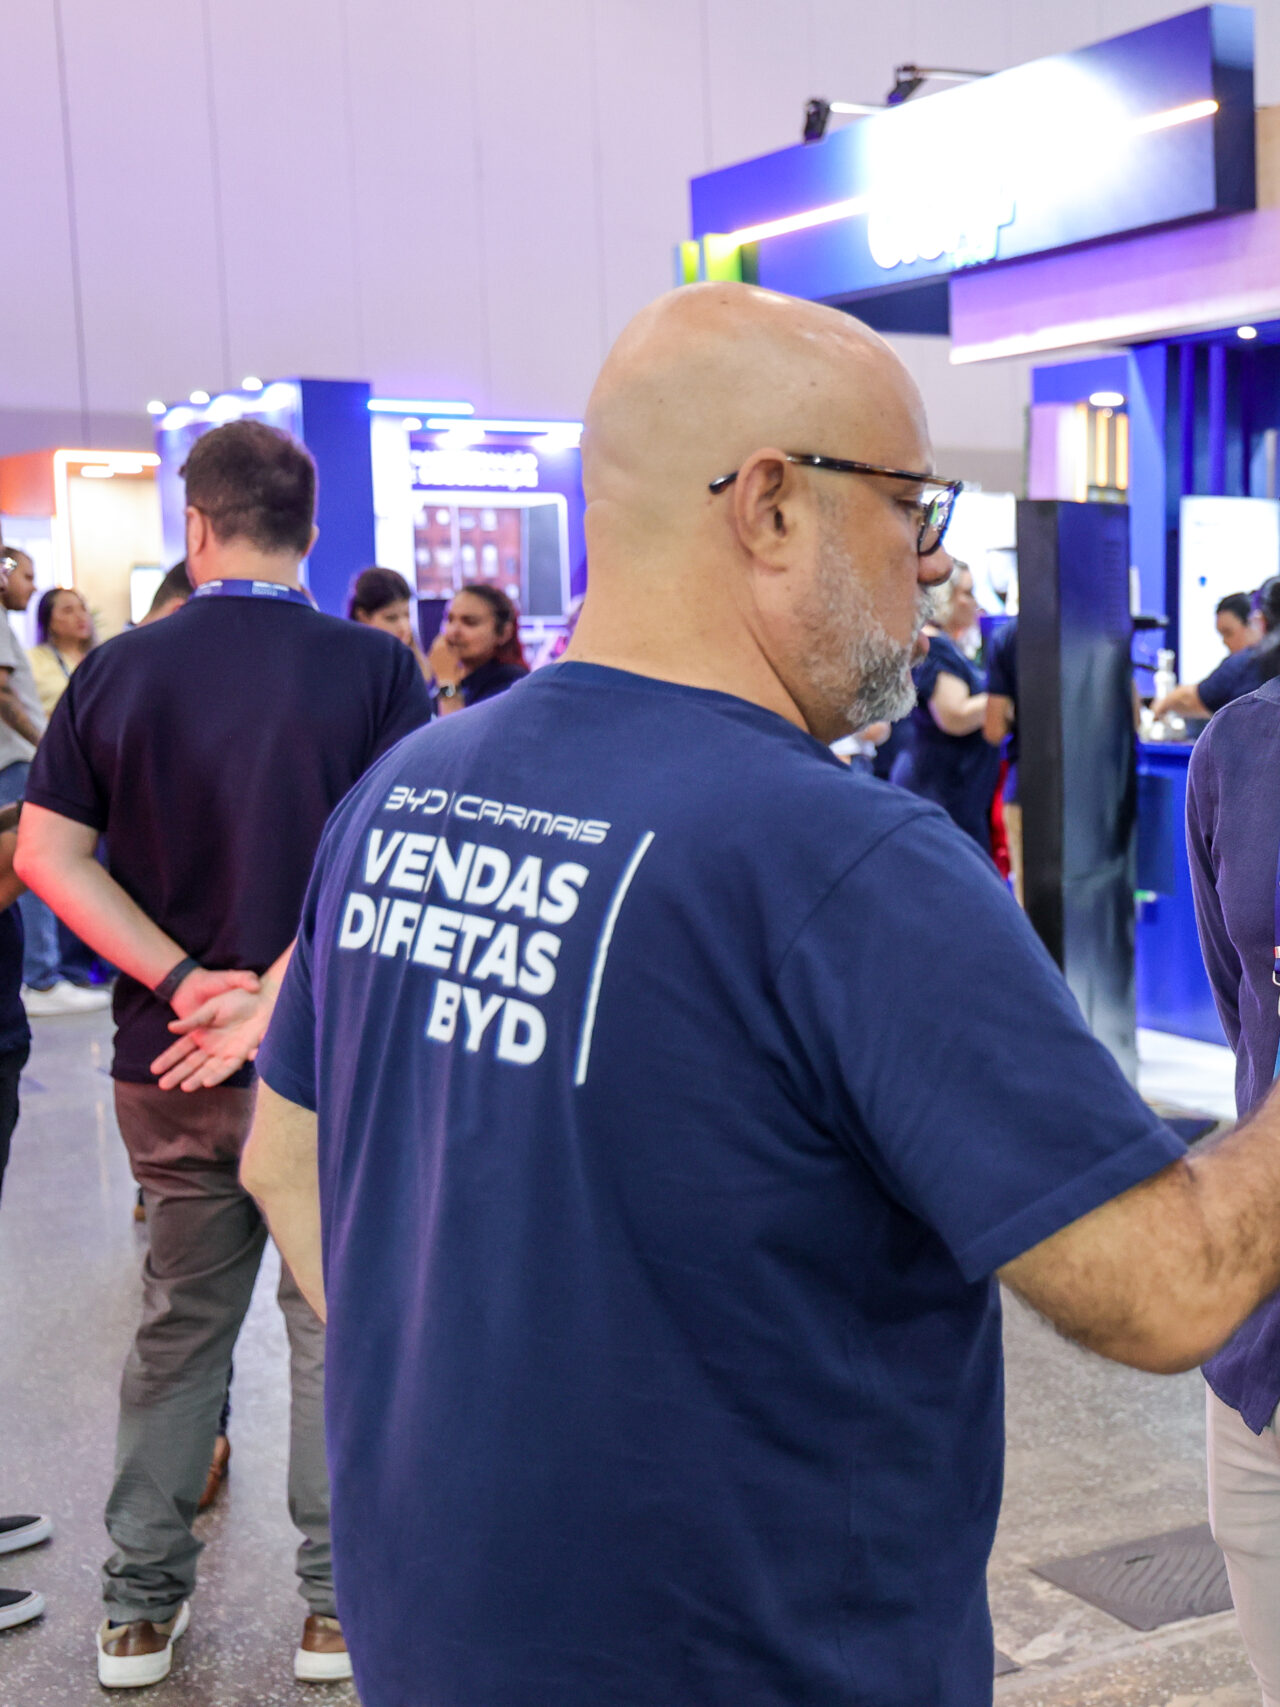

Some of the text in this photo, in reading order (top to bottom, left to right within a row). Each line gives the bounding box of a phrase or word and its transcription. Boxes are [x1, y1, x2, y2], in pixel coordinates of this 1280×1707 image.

[384, 785, 611, 844] BYD CARMAIS
[362, 828, 590, 924] VENDAS
[426, 978, 547, 1065] BYD
